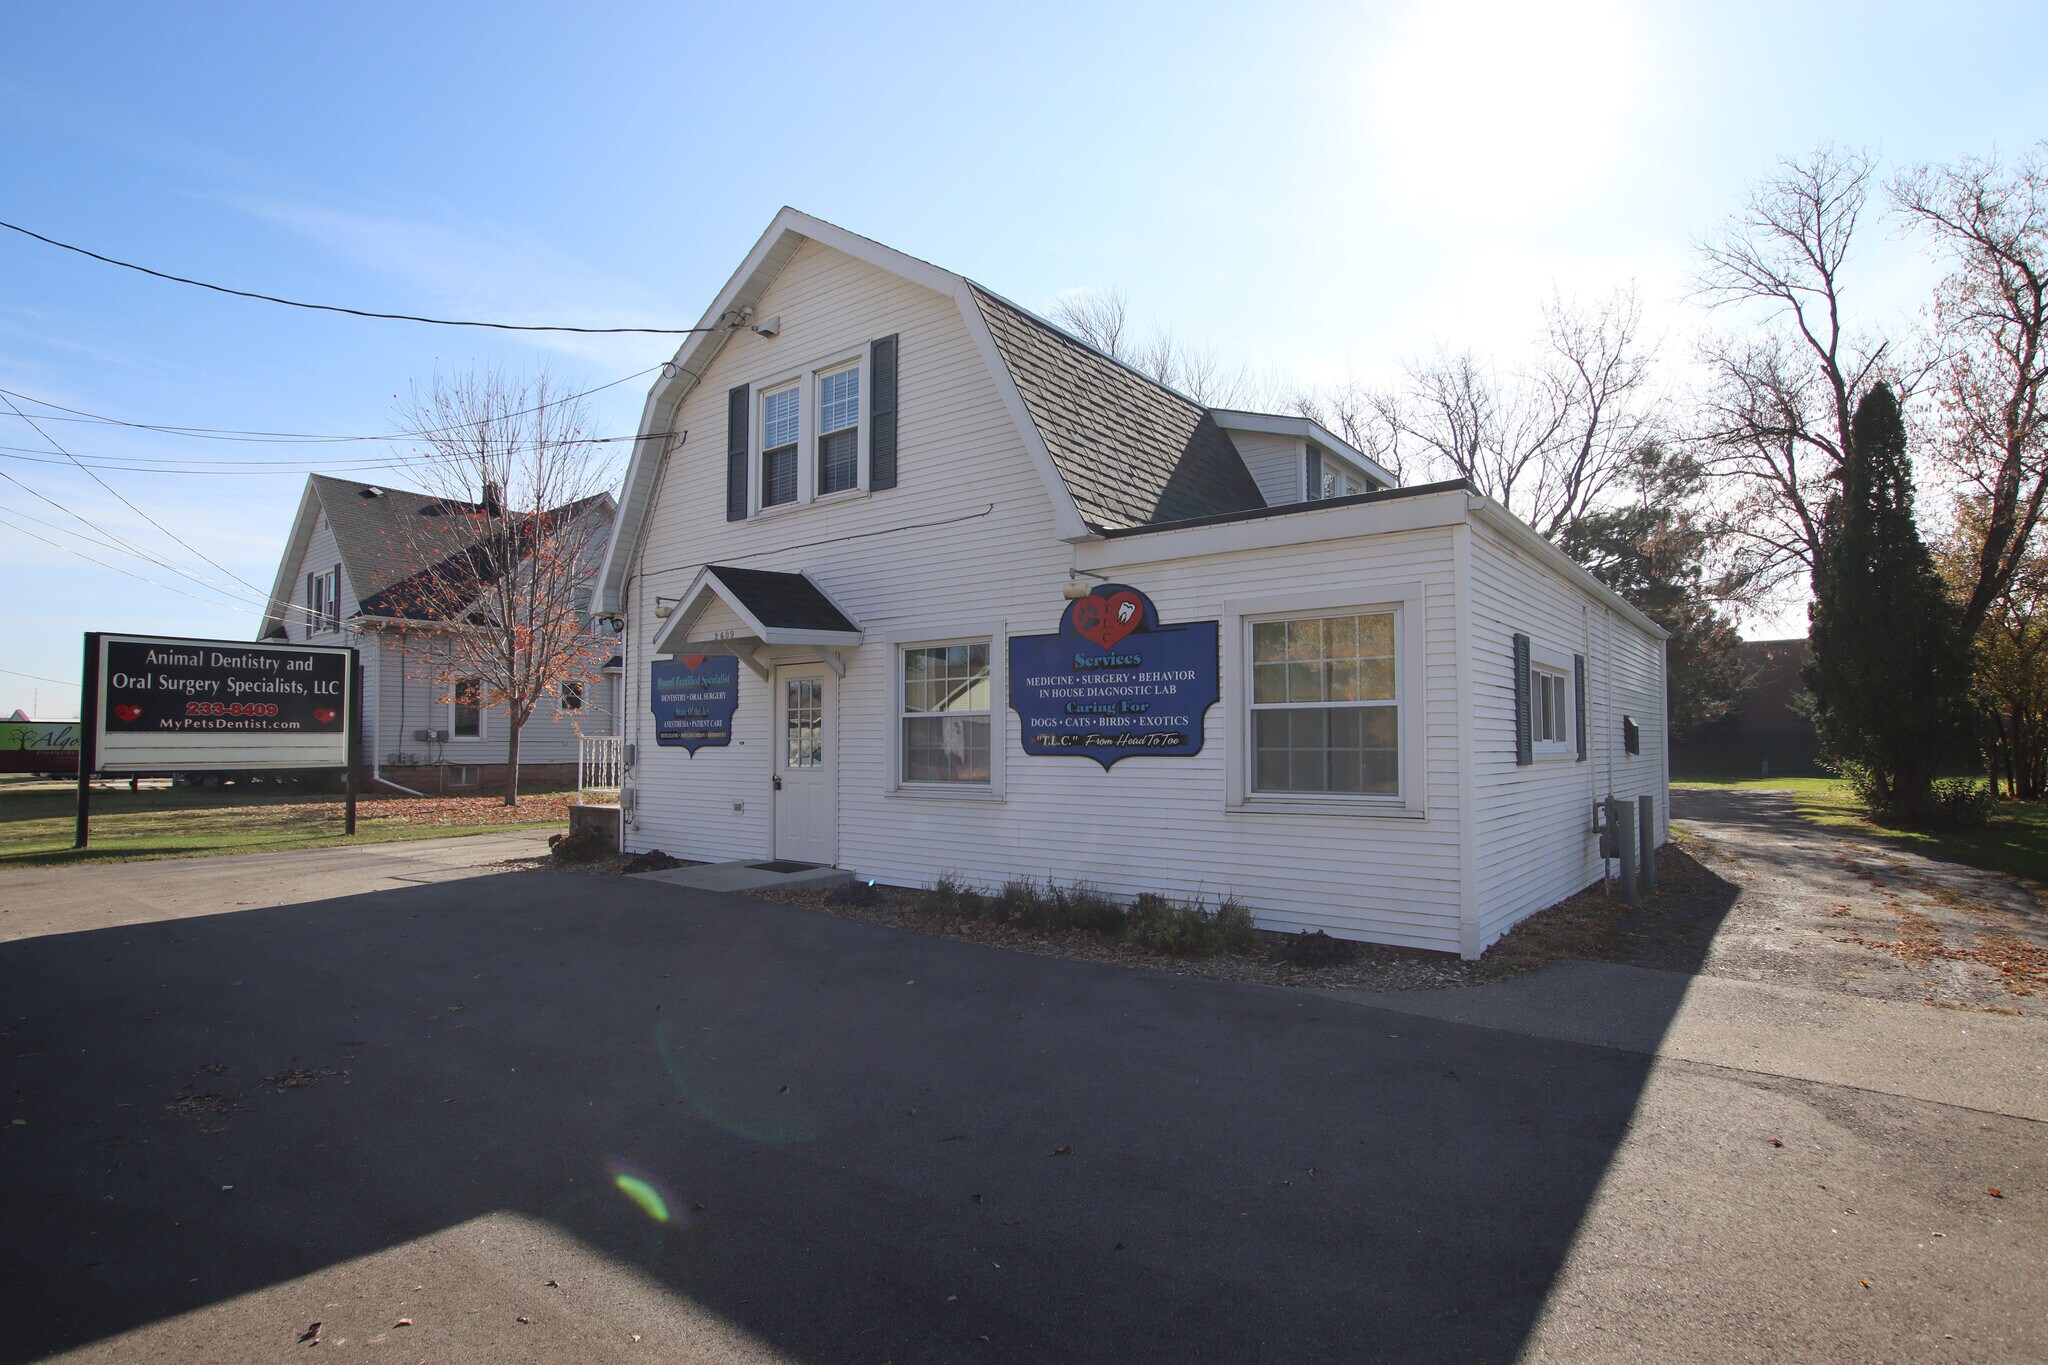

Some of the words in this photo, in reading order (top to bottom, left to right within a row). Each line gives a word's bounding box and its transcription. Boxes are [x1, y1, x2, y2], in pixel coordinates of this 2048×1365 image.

[145, 649, 204, 667] Animal
[211, 652, 280, 674] Dentistry
[286, 656, 313, 671] and
[1074, 651, 1142, 668] Services
[112, 672, 152, 689] Oral
[158, 674, 220, 696] Surgery
[227, 677, 308, 696] Specialists,
[313, 680, 339, 695] LLC
[1026, 675, 1074, 687] MEDICINE
[1081, 673, 1130, 685] SURGERY
[1138, 670, 1196, 682] BEHAVIOR
[661, 693, 687, 702] DENTISTRY
[689, 692, 703, 701] ORAL
[703, 691, 727, 700] SURGERY
[1039, 688, 1050, 698] IN
[1052, 687, 1085, 698] HOUSE
[1087, 685, 1152, 697] DIAGNOSTIC
[1154, 684, 1177, 695] LAB
[185, 702, 279, 717] 233-8409
[1066, 701, 1116, 715] Caring
[1121, 700, 1149, 712] For
[160, 718, 300, 731] MyPetsDentist.com
[1030, 718, 1057, 727] DOGS
[1065, 717, 1091, 727] CATS
[1099, 716, 1131, 727] BIRDS
[1139, 715, 1189, 726] EXOTICS
[30, 726, 80, 751] Algo
[1084, 734, 1114, 747] From
[1115, 733, 1145, 747] Head
[1147, 733, 1159, 746] To
[1159, 733, 1179, 746] Toe
